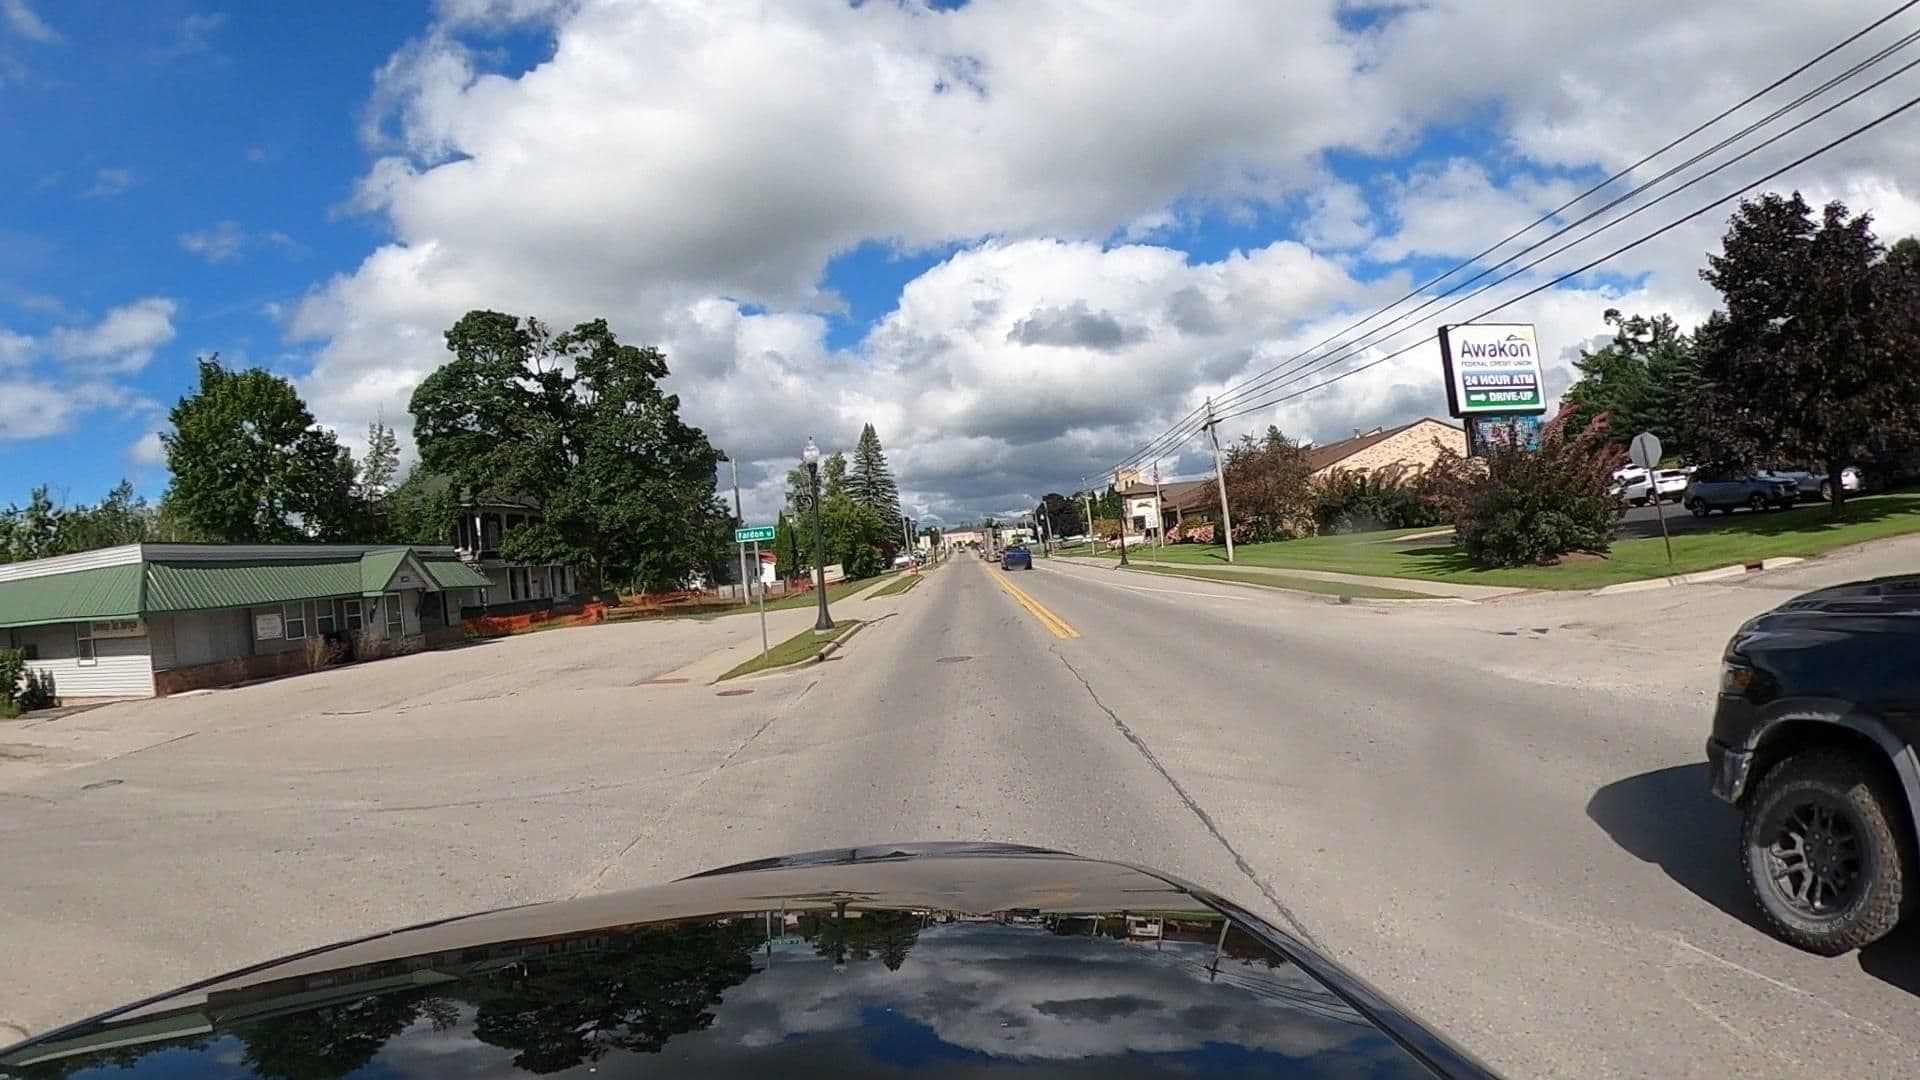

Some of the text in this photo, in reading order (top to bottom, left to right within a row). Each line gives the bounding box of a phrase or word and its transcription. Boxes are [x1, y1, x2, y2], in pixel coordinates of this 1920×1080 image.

[1461, 339, 1531, 358] Awakon
[1464, 374, 1535, 386] 24 HOUR ATM
[1489, 391, 1534, 402] DRIVE-UP
